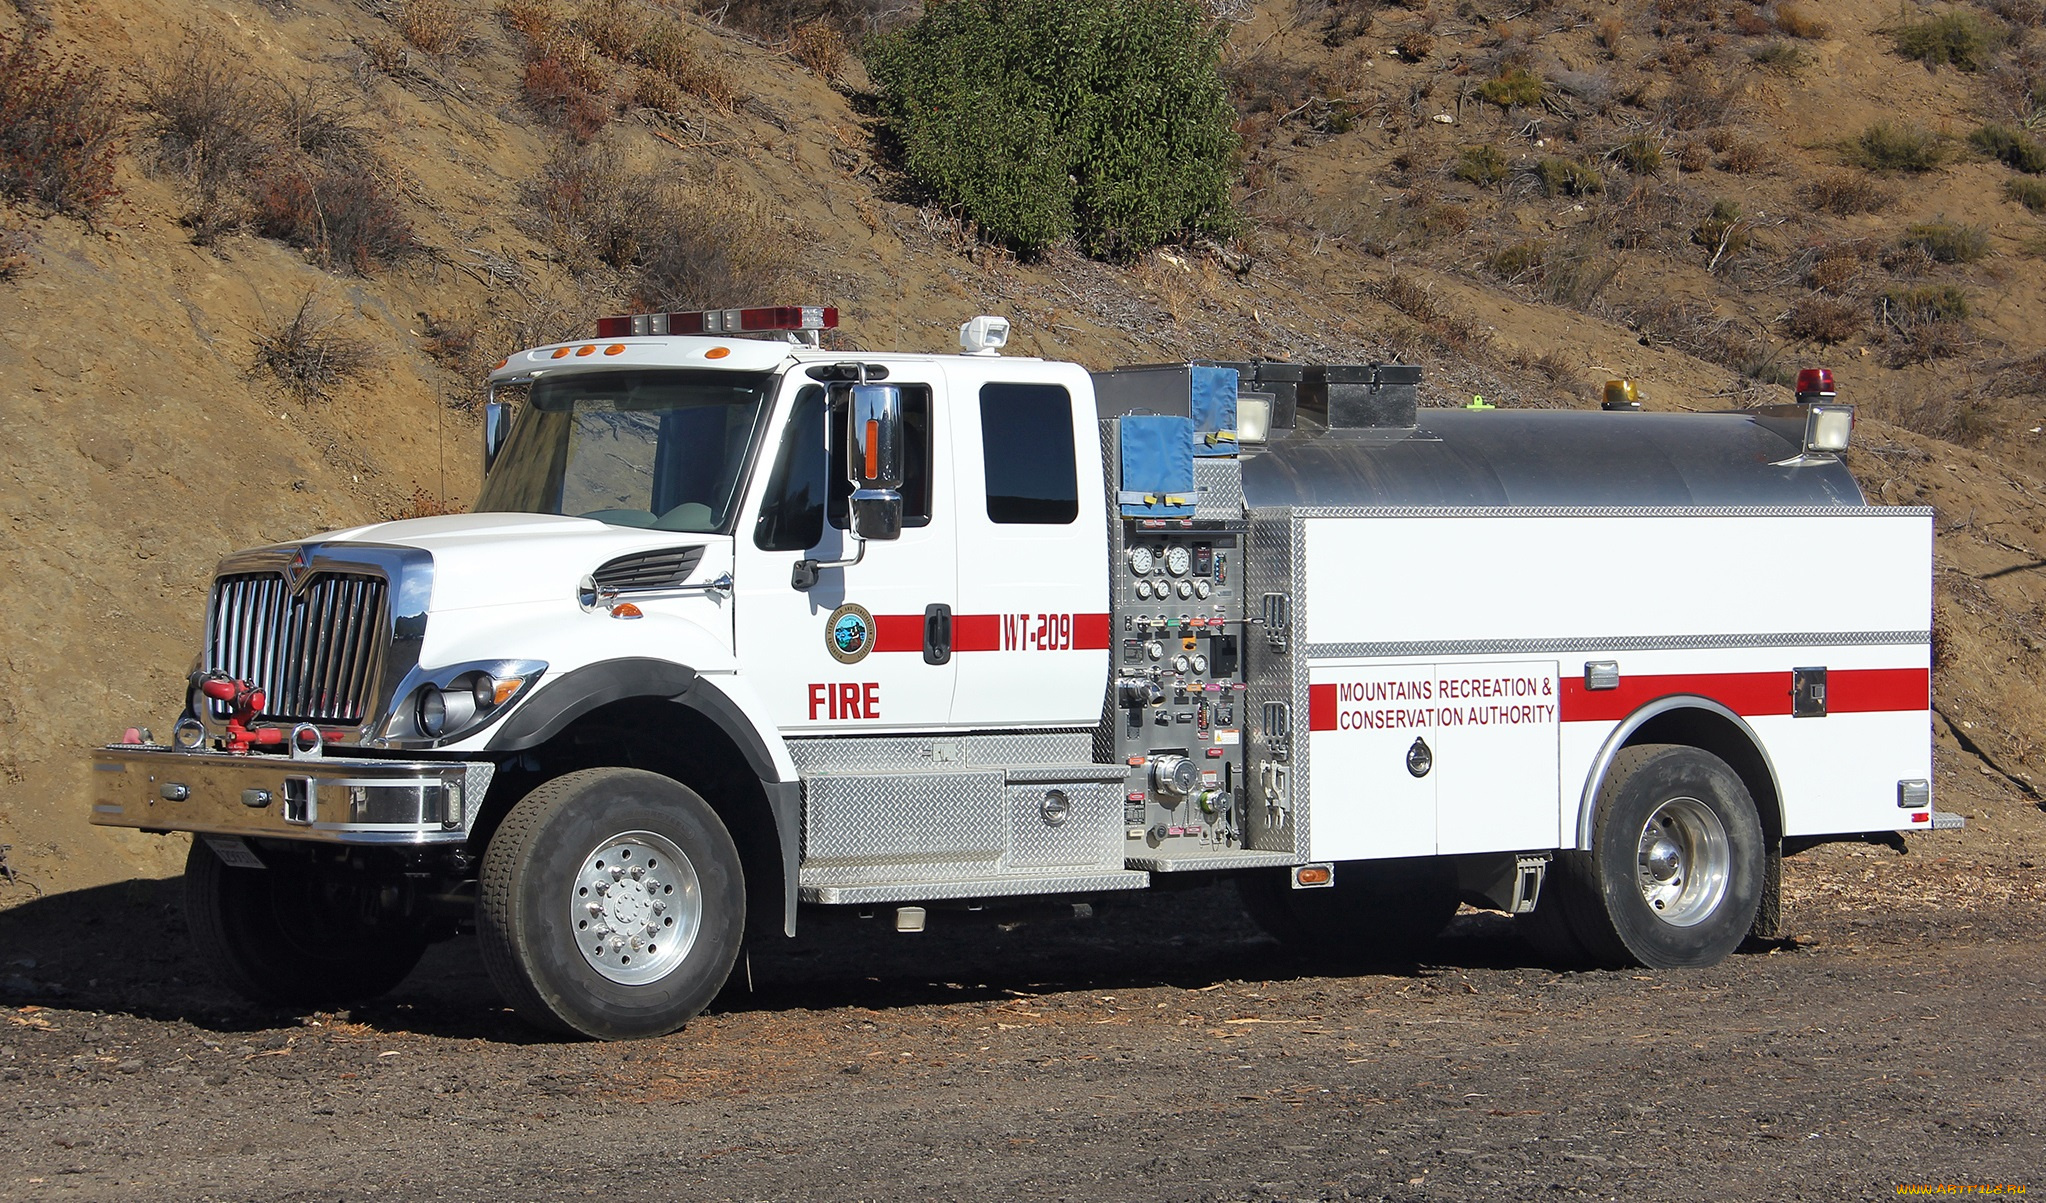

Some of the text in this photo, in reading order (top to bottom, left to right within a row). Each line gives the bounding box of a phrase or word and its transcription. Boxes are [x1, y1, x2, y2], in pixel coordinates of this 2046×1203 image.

[1004, 613, 1070, 651] WT-209
[808, 683, 880, 720] FIRE
[1340, 677, 1552, 701] MOUNTAINS RECREATION &
[1340, 705, 1555, 730] CONSERVATION AUTHORITY
